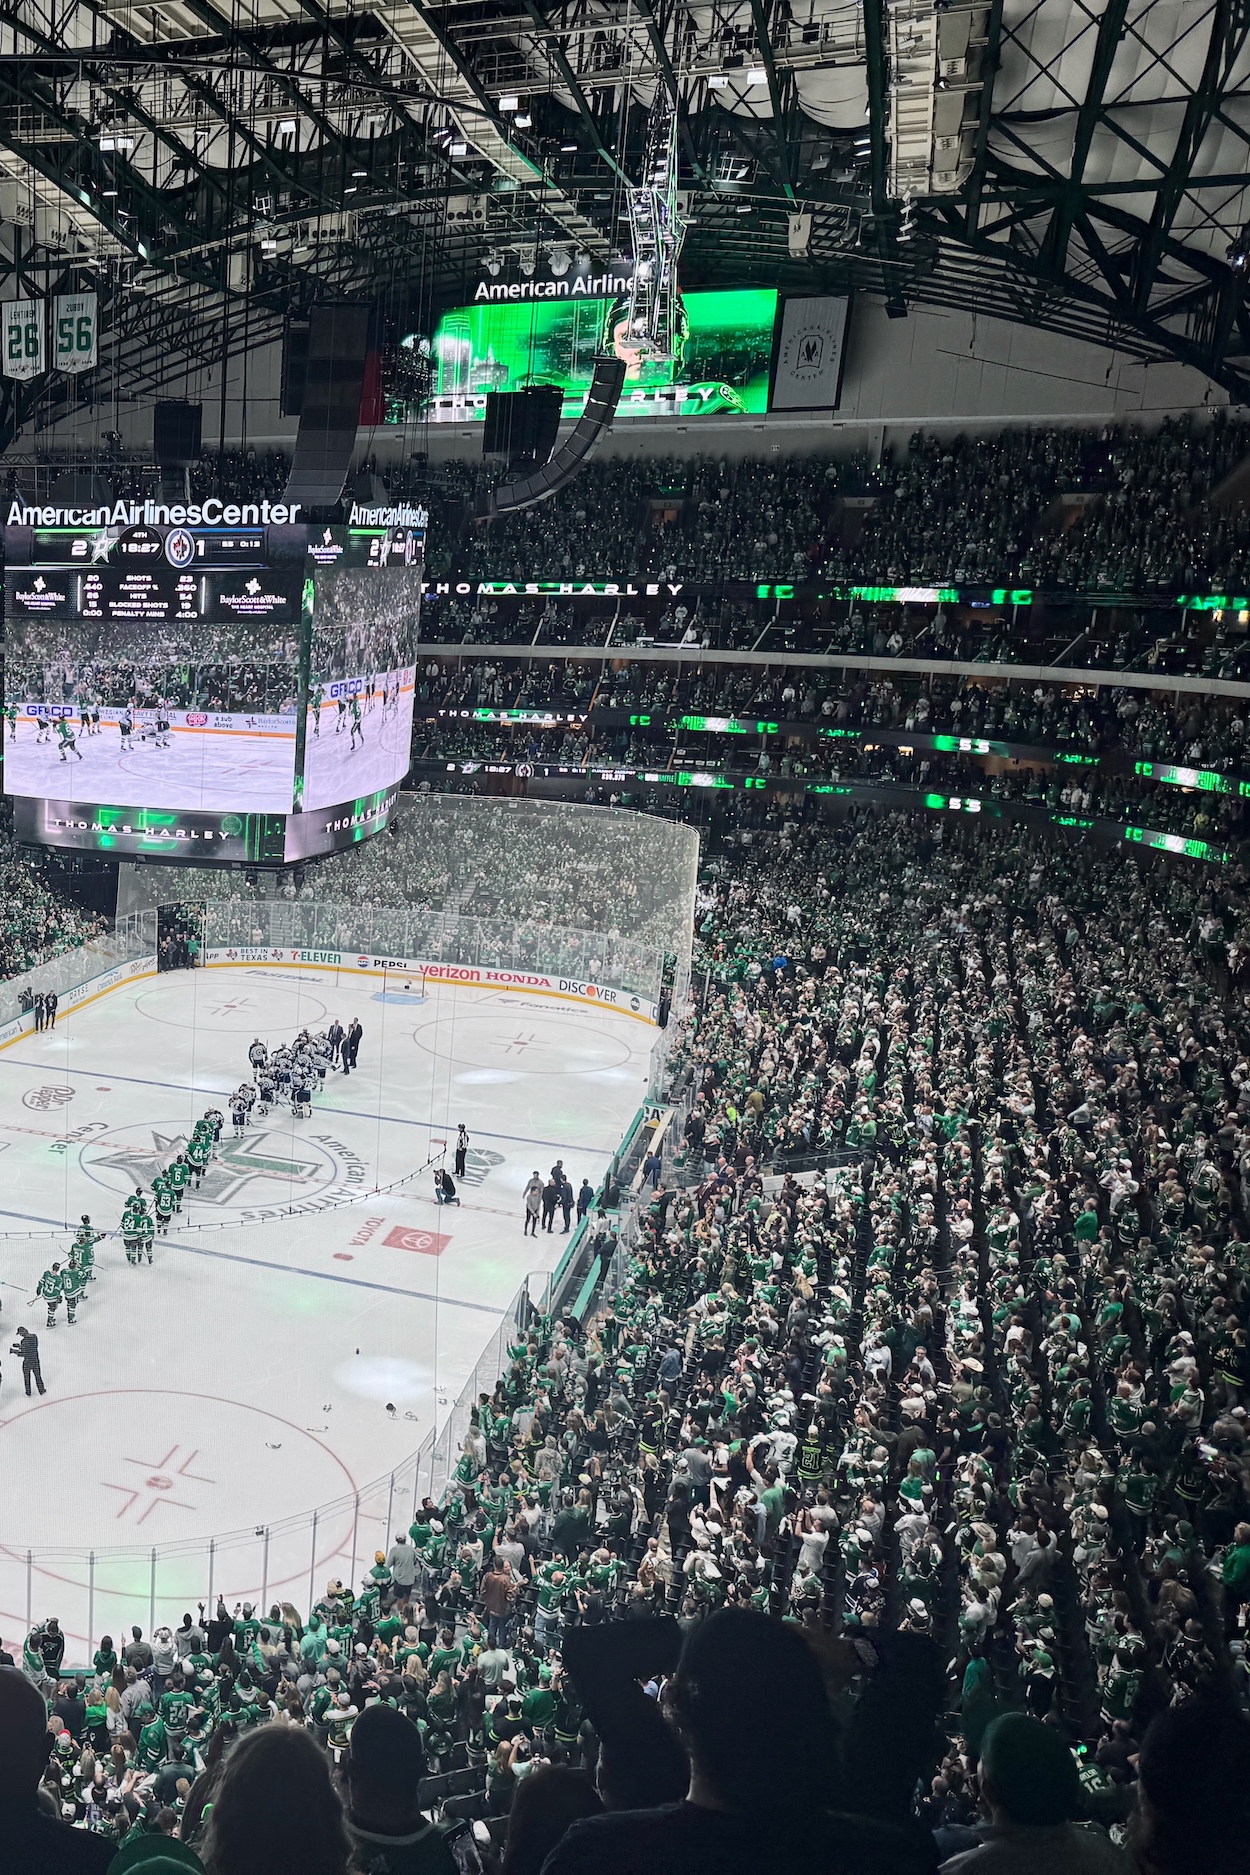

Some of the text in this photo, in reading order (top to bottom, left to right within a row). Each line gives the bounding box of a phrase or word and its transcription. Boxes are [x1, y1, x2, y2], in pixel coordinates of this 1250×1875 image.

[475, 277, 569, 301] American
[8, 323, 39, 360] 26
[58, 316, 92, 353] 56
[71, 540, 88, 556] 2
[121, 542, 160, 554] 18:27
[196, 540, 205, 556] 1
[370, 539, 380, 557] 2
[420, 583, 684, 596] THOMAS HARLEY
[83, 609, 103, 617] 0:00
[175, 611, 198, 619] 4:00
[438, 709, 589, 723] THOMAS HARLEY
[54, 818, 231, 841] THOMAS HARLEY
[325, 812, 372, 834] THOMAS
[290, 950, 342, 965] 7-ELEVEN
[419, 964, 481, 981] verizon
[485, 971, 552, 988] HONDA
[559, 979, 617, 1003] DISCOVER
[520, 1001, 589, 1014] Fanatics
[47, 1122, 110, 1155] Center
[192, 1148, 204, 1159] 44
[308, 1133, 372, 1185] American
[174, 1170, 181, 1182] 6
[160, 1195, 171, 1208] 63
[124, 1219, 136, 1231] 24
[348, 1217, 386, 1247] TOYOTA
[634, 1355, 647, 1368] 55
[782, 1445, 792, 1460] 4
[800, 1452, 820, 1470] 21
